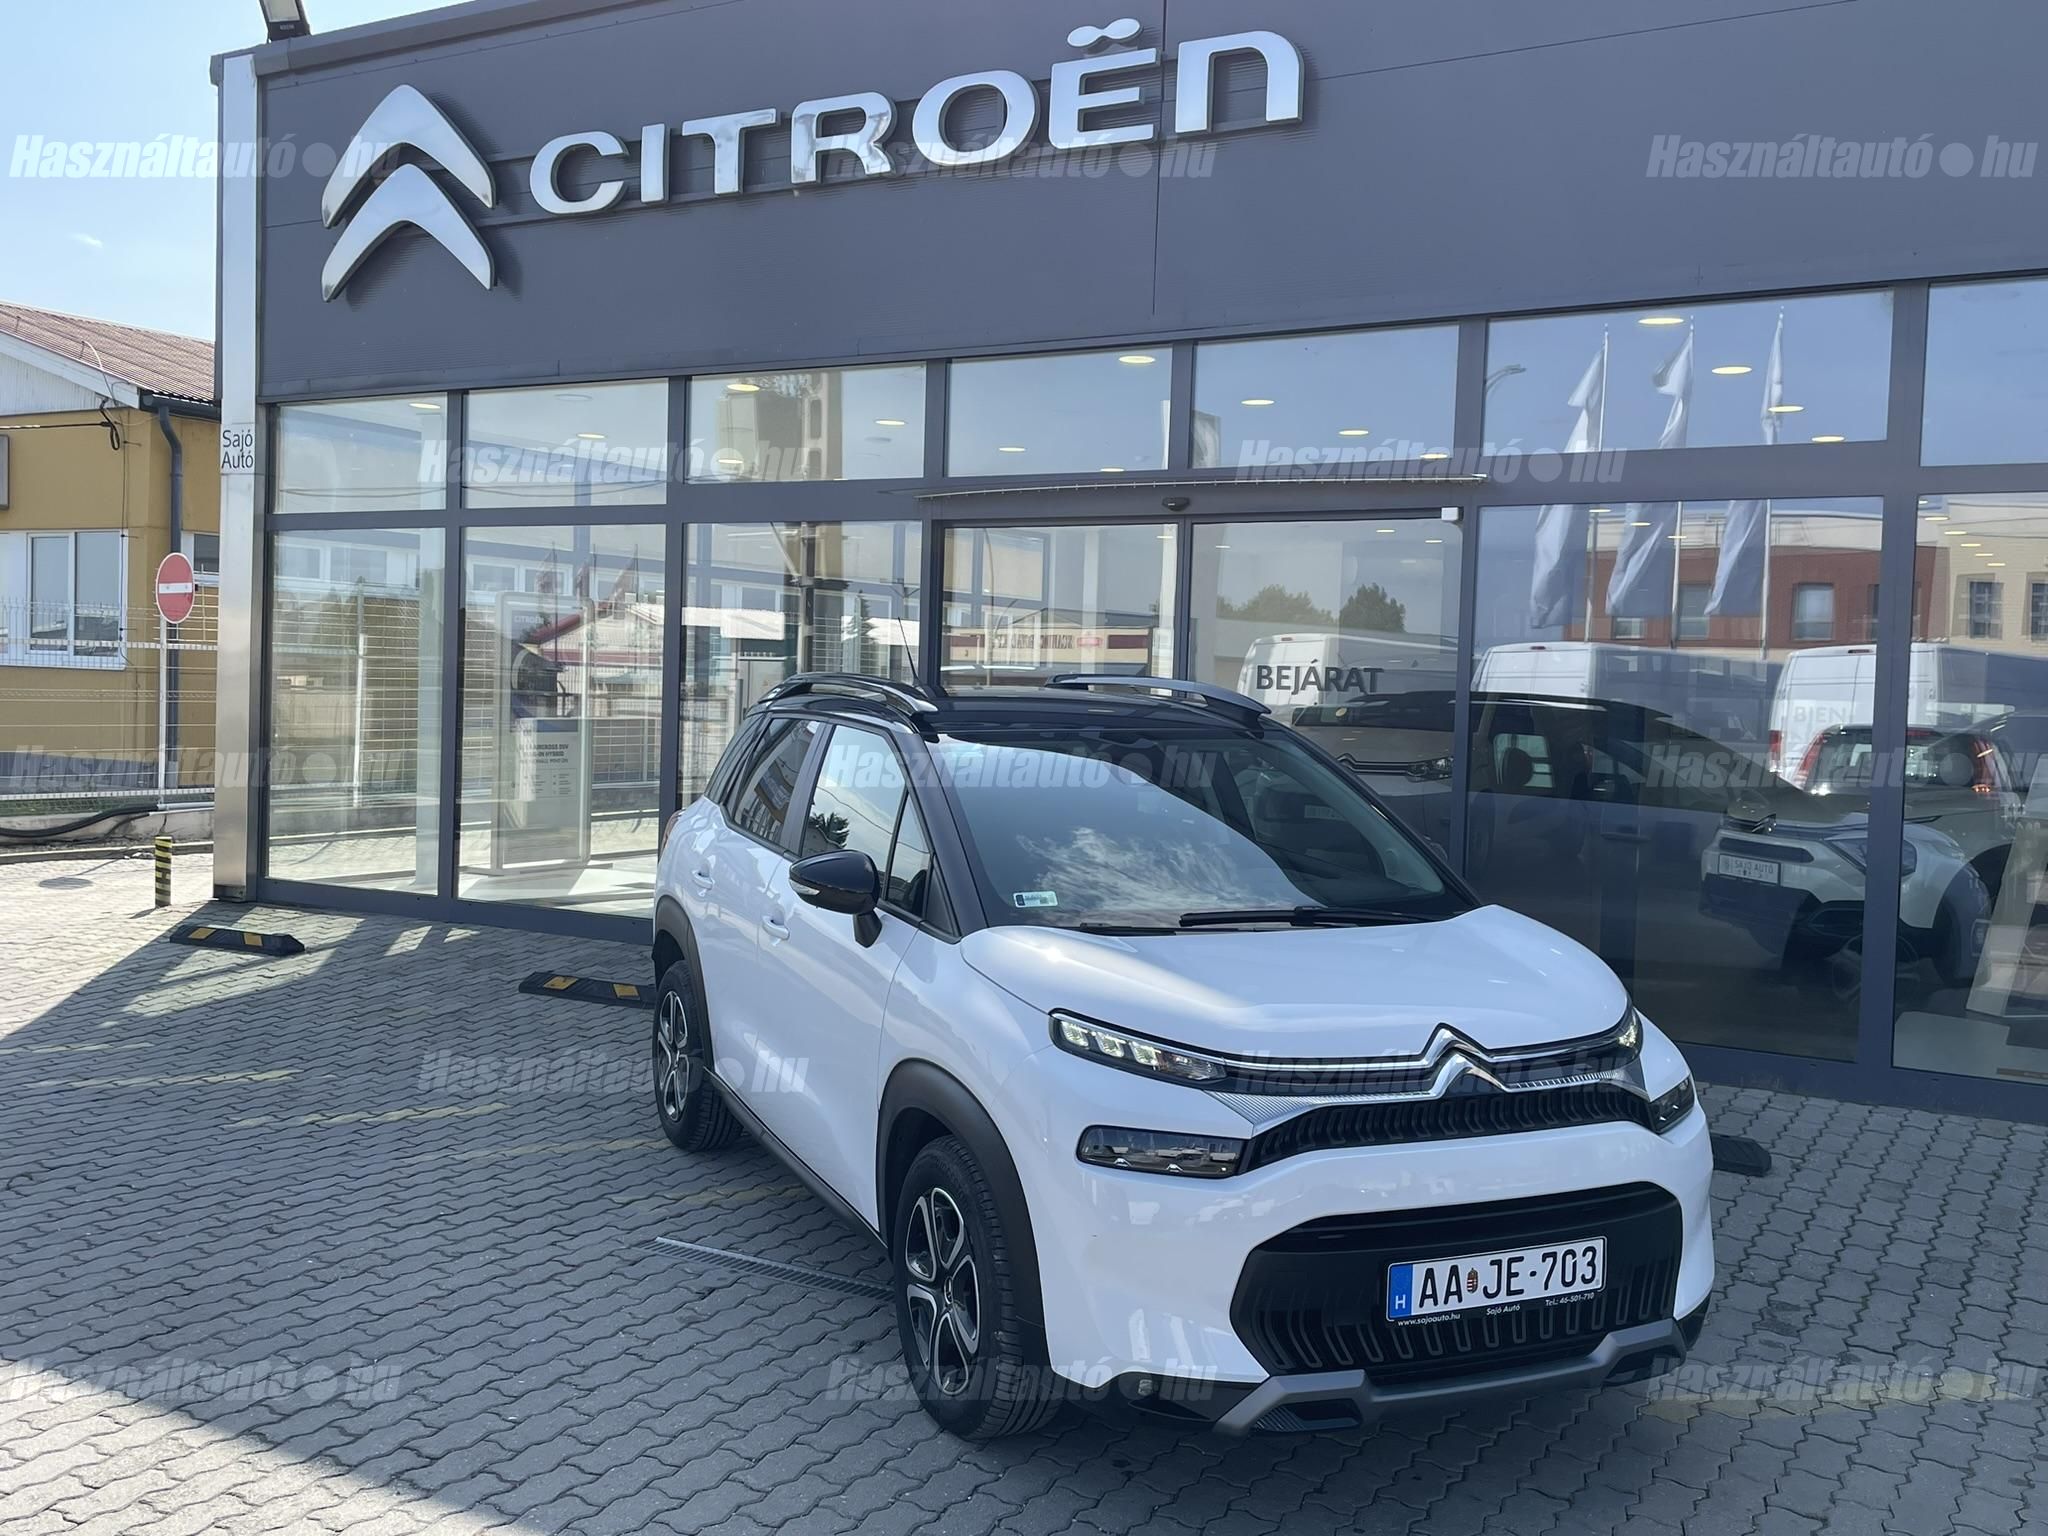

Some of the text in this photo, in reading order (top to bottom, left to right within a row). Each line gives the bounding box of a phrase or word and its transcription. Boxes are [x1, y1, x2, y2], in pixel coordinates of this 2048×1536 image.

[222, 429, 253, 452] Sajó
[221, 450, 254, 469] Autó
[1256, 659, 1385, 695] BEJÁRAT
[1395, 1294, 1406, 1310] H
[1486, 1304, 1521, 1316] Sajó Autó
